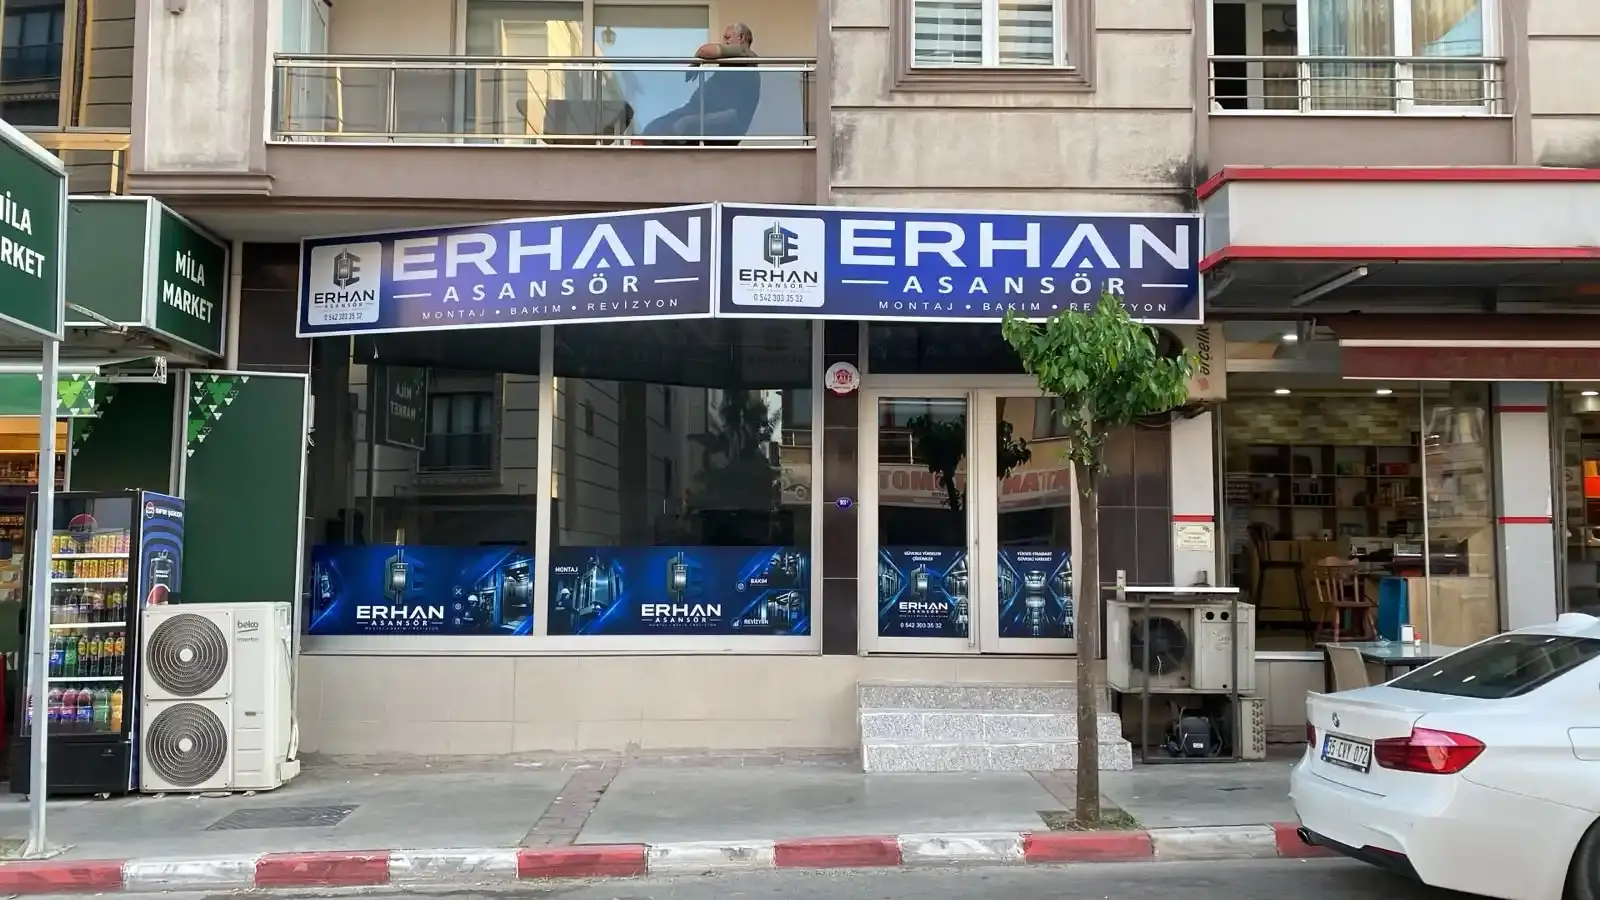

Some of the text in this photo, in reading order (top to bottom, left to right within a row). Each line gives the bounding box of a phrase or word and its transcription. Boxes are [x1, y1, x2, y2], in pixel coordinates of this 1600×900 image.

[392, 216, 702, 282] ERHAN
[840, 218, 1190, 270] ERHAN
[175, 250, 205, 287] MİLA
[739, 269, 818, 284] ERHAN
[442, 272, 639, 303] ASANSÖR
[903, 272, 1125, 295] ASANSÖR
[163, 279, 214, 324] MARKET
[314, 289, 375, 304] ERHAN
[878, 300, 954, 311] MONTAJ
[983, 302, 1041, 312] BAKIM
[422, 297, 678, 320] MONTAJ BAKIM REVİZYON
[356, 605, 444, 619] ERHAN
[641, 603, 722, 617] ERHAN
[899, 601, 948, 610] ERHAN
[237, 619, 259, 629] beko
[1337, 741, 1353, 761] CVY
[1353, 745, 1368, 765] 072
